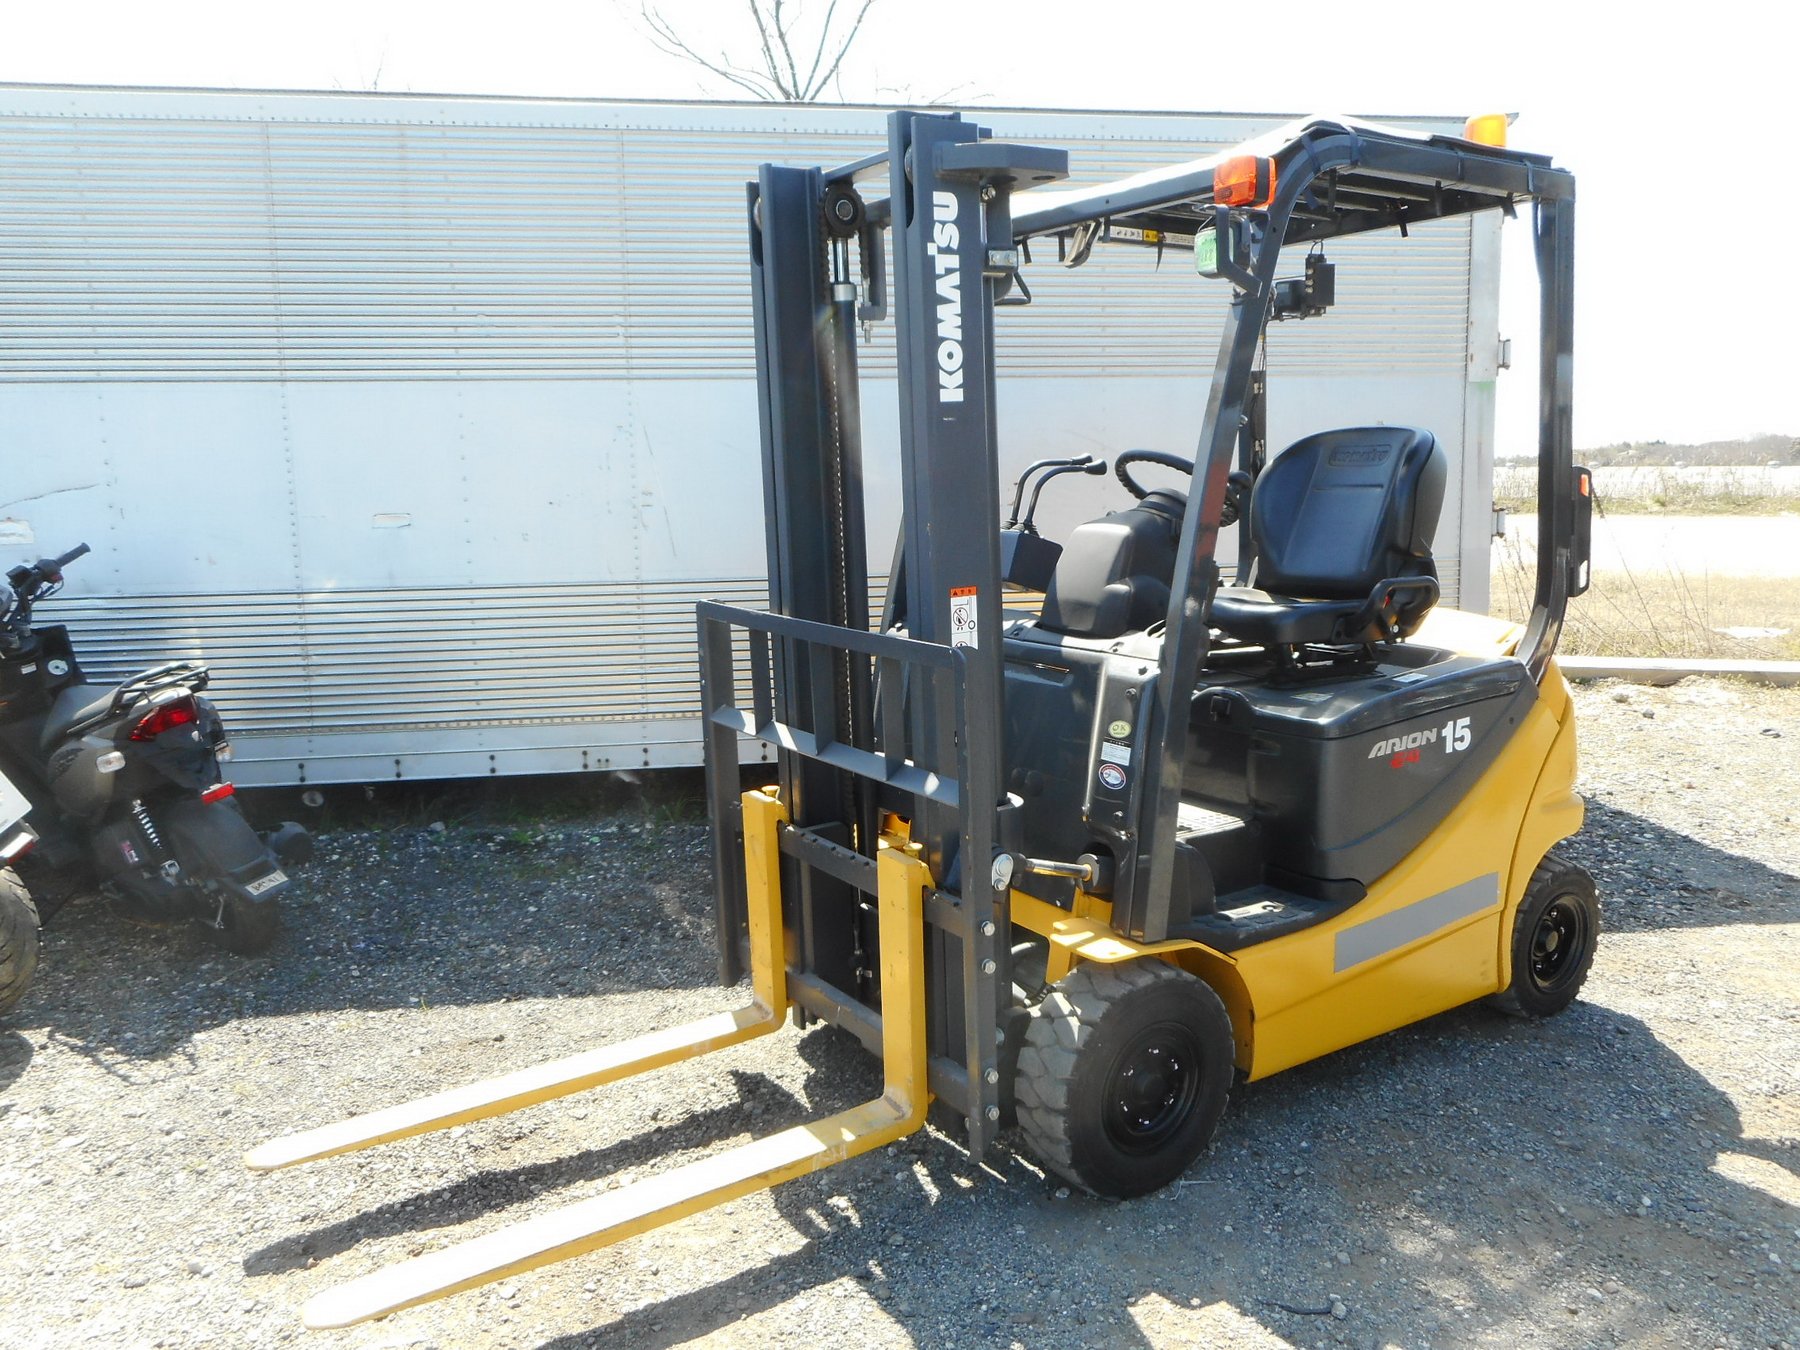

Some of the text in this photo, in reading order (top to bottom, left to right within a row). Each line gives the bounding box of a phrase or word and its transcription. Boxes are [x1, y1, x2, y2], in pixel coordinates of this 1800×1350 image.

[927, 190, 964, 403] KOMATSU
[1367, 716, 1472, 759] ARION 15
